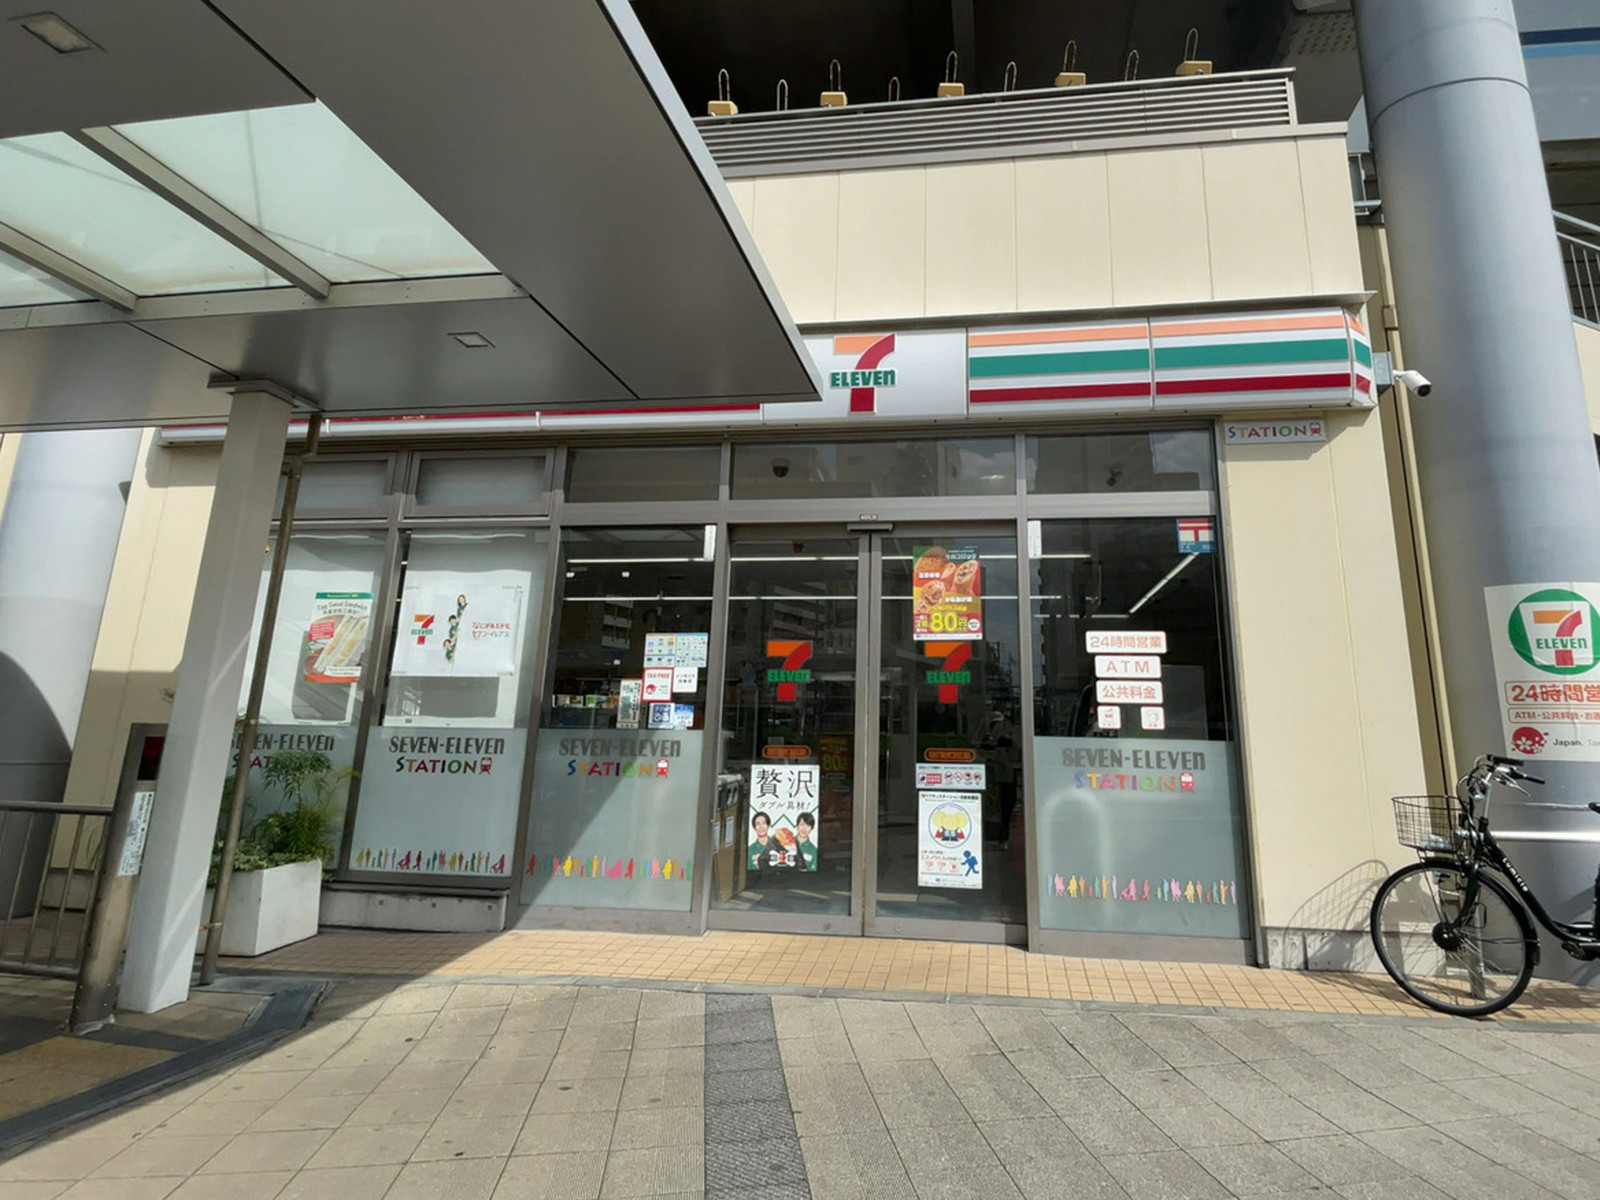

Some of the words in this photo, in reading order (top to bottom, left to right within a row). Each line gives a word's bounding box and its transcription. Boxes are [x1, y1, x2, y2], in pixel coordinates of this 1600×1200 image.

[1228, 425, 1307, 438] STATION
[1090, 636, 1161, 649] 24時間営業
[1106, 661, 1149, 673] ATM
[1103, 685, 1156, 699] 公共料金
[395, 756, 477, 774] STATION
[567, 759, 653, 777] STATION
[756, 768, 814, 799] 贅沢
[1074, 770, 1177, 792] STATION
